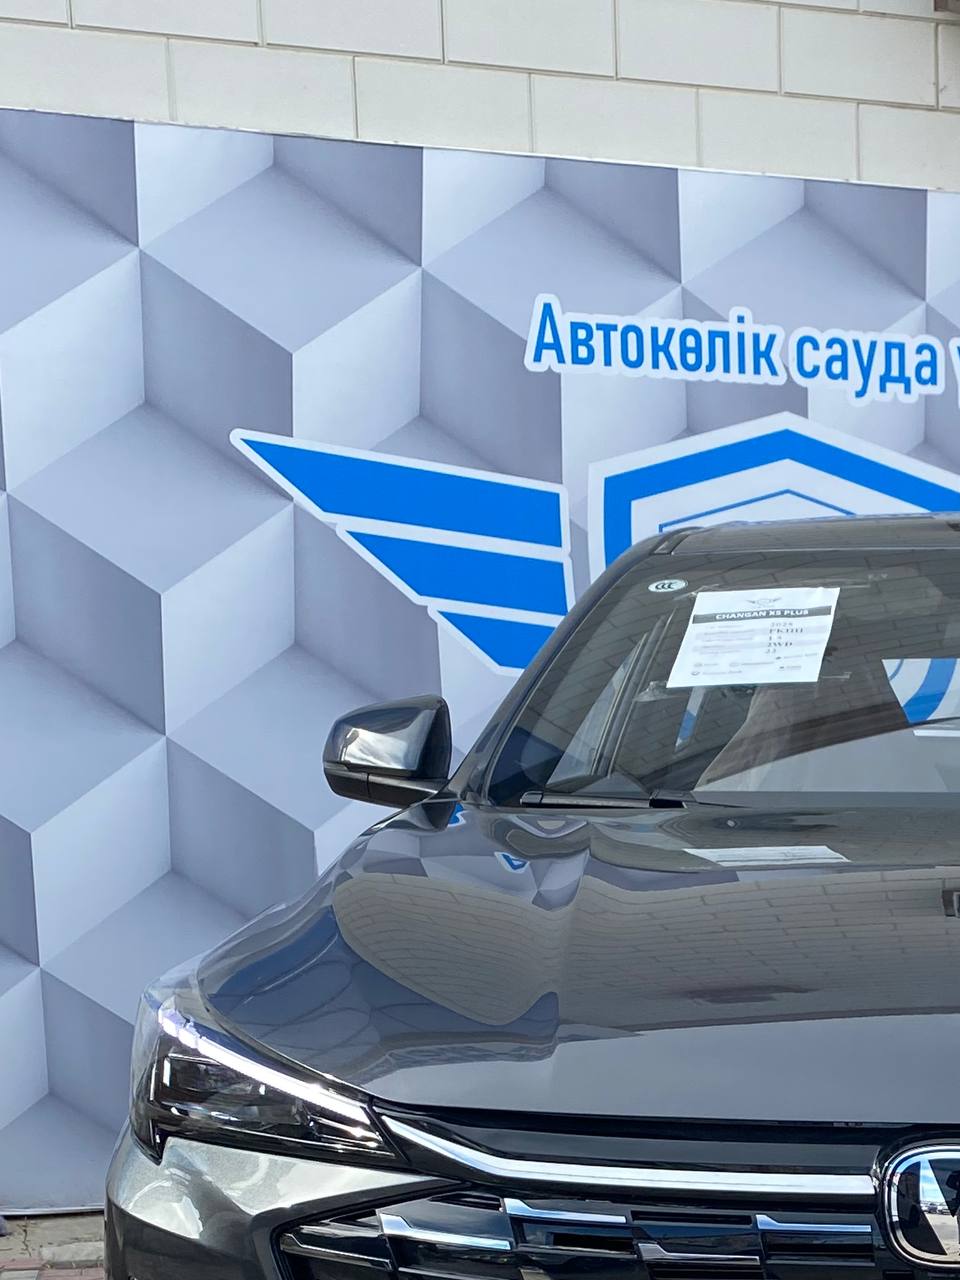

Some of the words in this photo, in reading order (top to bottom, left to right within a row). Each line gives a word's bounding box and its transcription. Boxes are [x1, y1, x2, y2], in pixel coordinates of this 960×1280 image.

[533, 302, 778, 376] Автокөлік
[796, 334, 938, 398] сауда
[715, 611, 767, 620] CHANGAN
